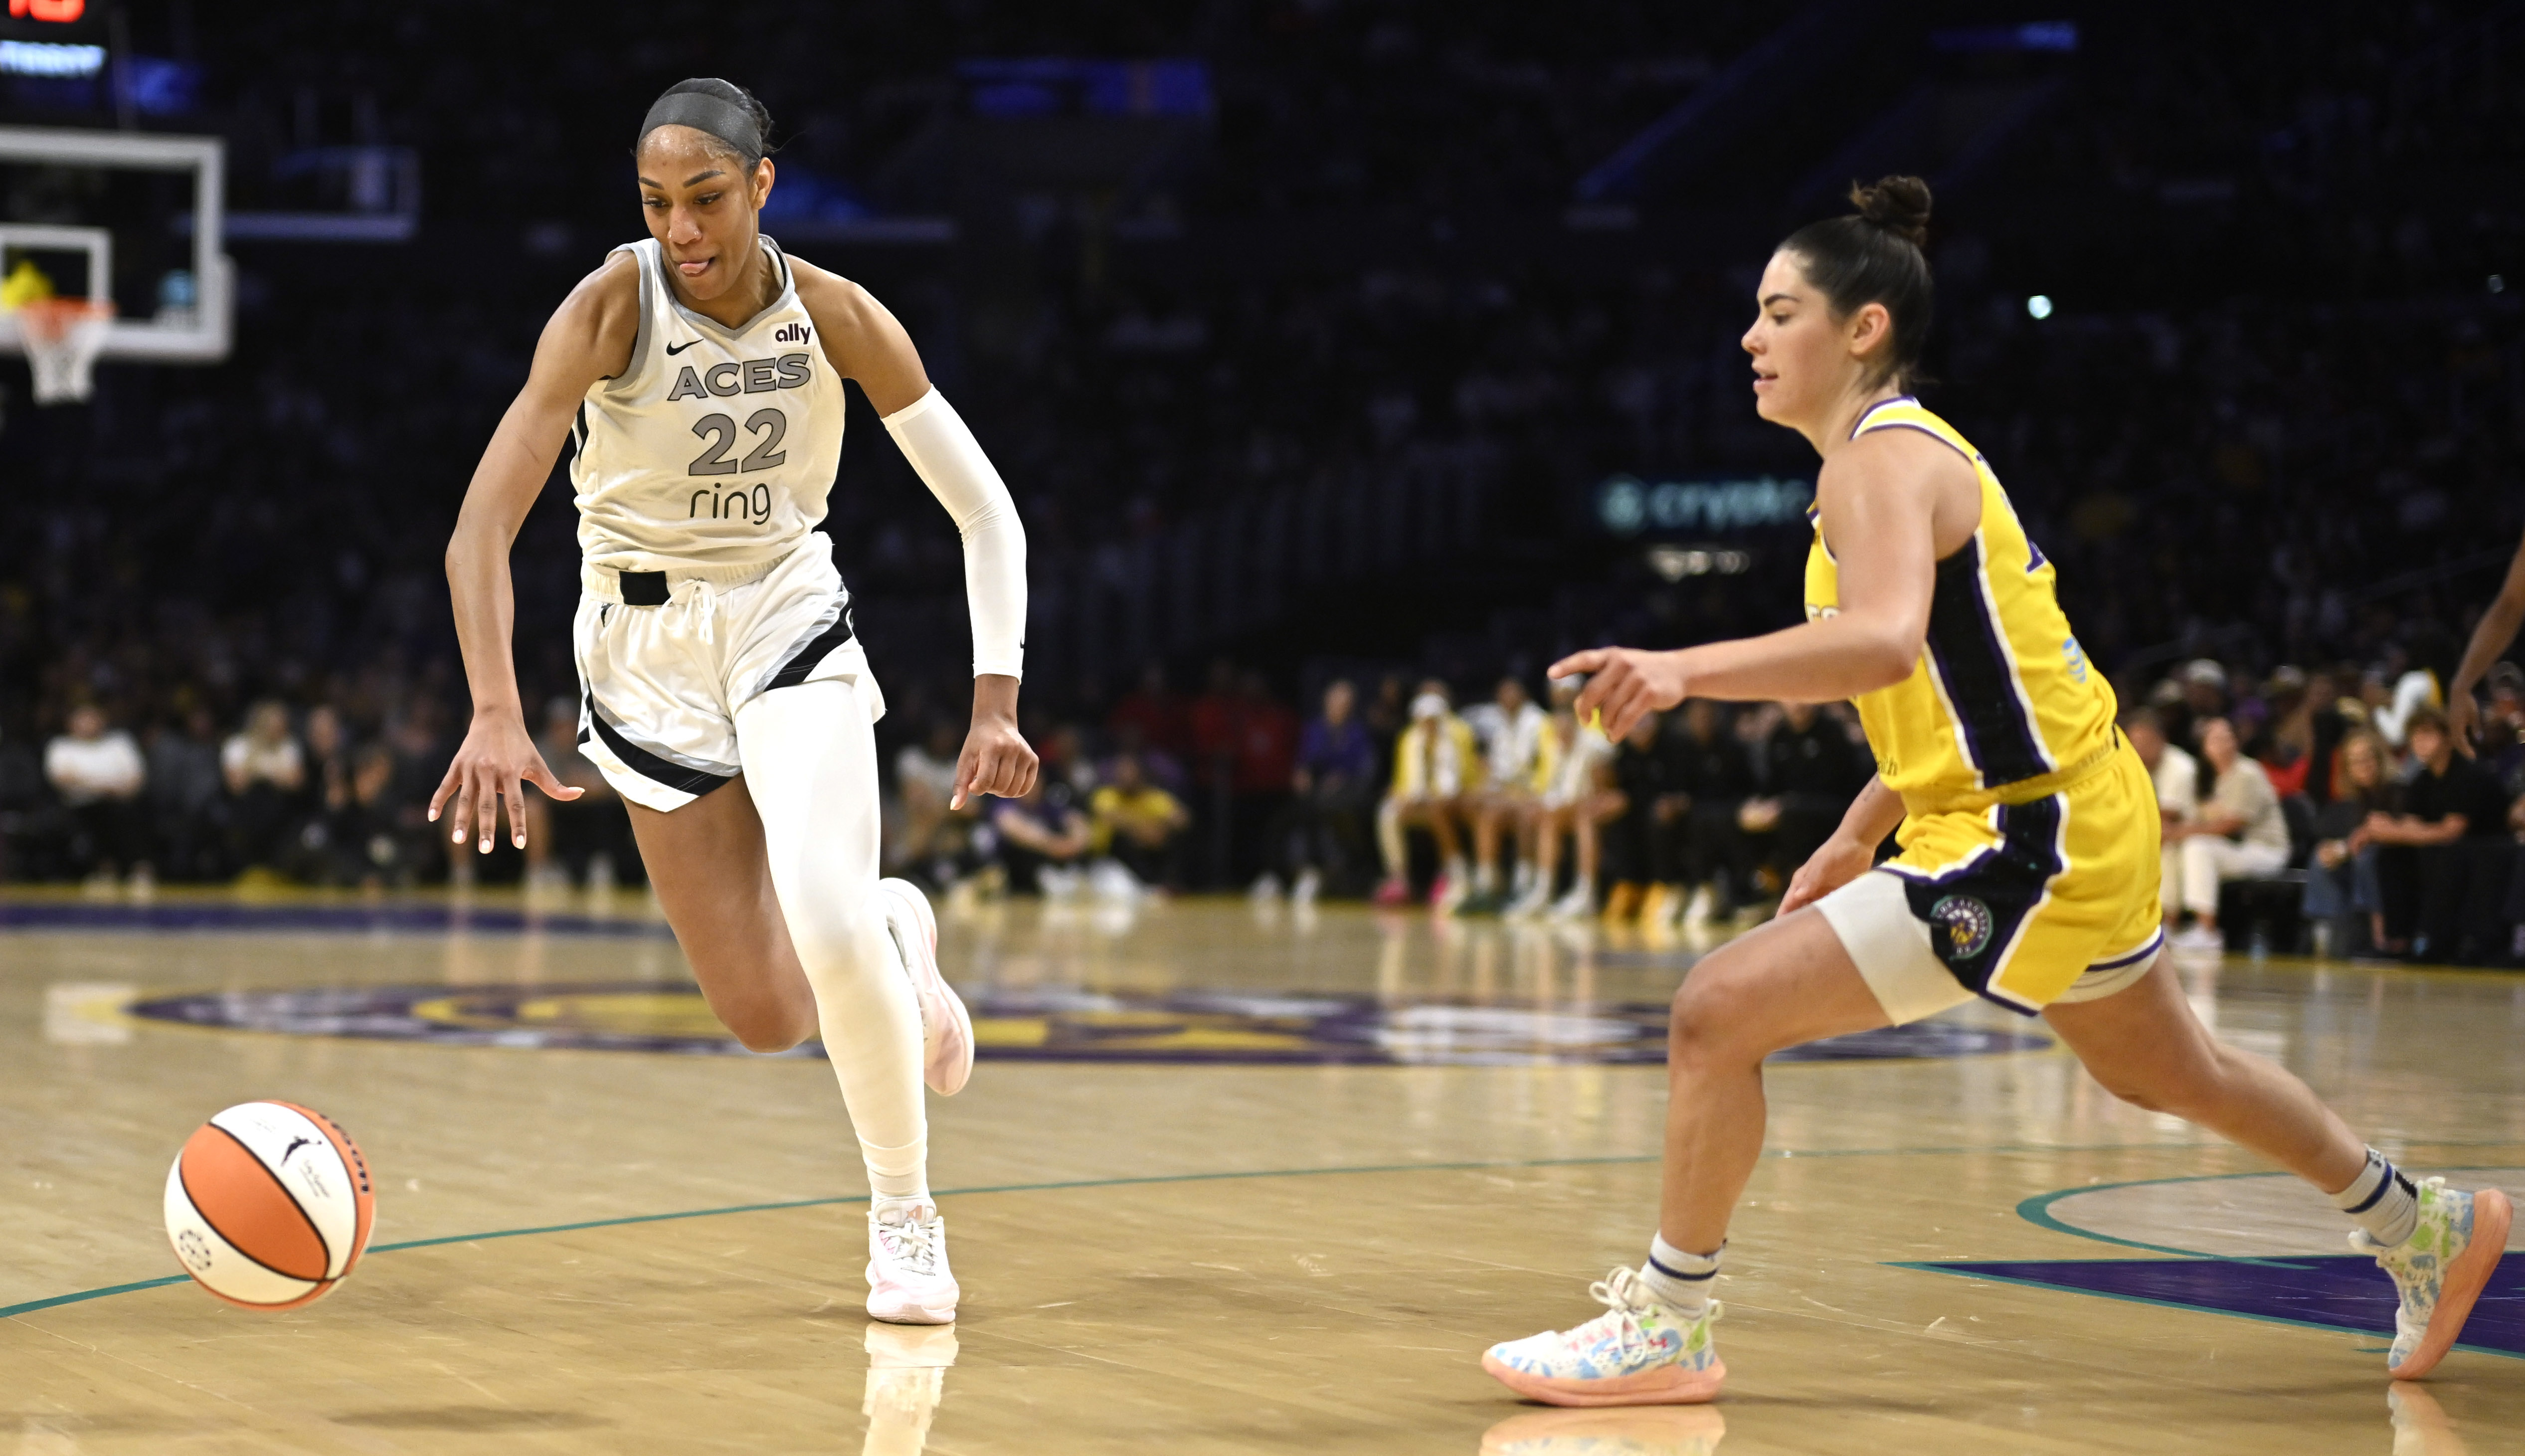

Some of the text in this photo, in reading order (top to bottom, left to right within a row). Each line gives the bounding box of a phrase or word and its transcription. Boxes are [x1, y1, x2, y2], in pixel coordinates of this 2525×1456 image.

[775, 323, 811, 345] ally
[667, 354, 811, 401] ACES
[688, 408, 787, 476] 22
[689, 483, 771, 525] ring
